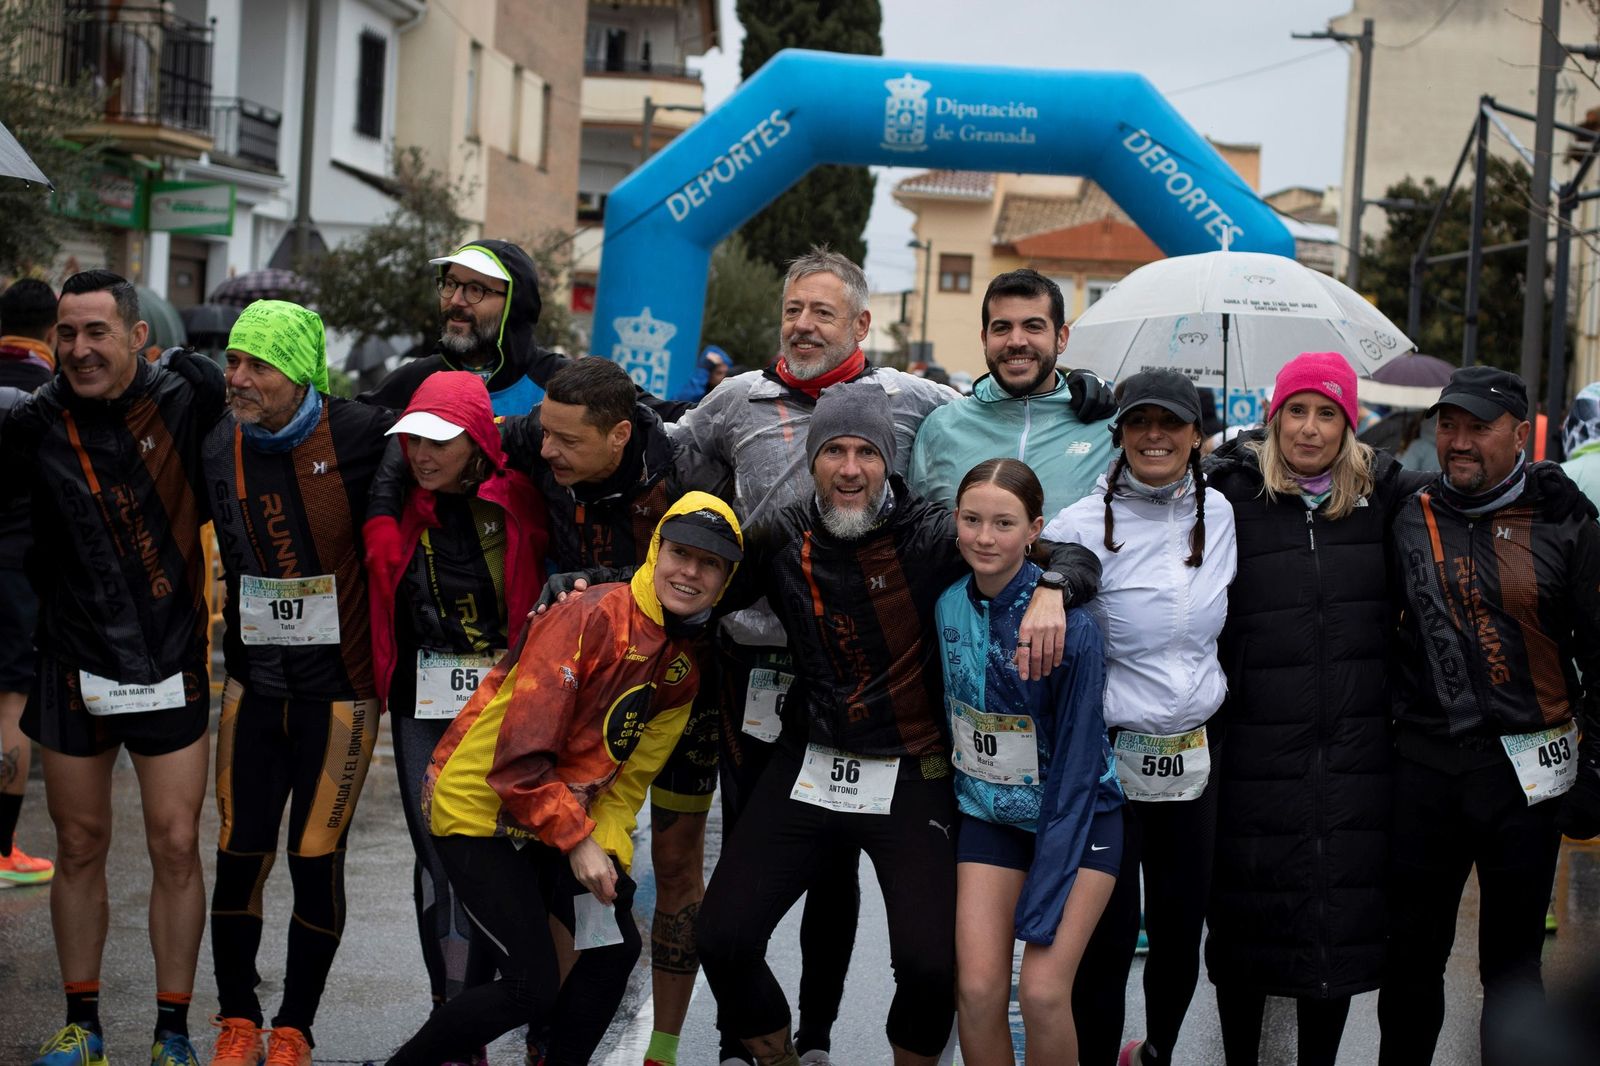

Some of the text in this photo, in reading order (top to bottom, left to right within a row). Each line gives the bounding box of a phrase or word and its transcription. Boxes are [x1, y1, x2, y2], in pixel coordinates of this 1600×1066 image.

[936, 97, 1038, 120] Diputación
[933, 123, 1036, 144] de Granada
[665, 109, 792, 222] DEPORTES
[1122, 128, 1245, 247] DEPORTES
[215, 480, 249, 572] GRAN
[258, 492, 302, 578] RUNN
[268, 598, 304, 620] 197
[1453, 555, 1512, 687] RUNNING
[1408, 547, 1466, 704] GRANADA
[421, 658, 459, 668] SECADEROS
[109, 688, 155, 697] FRAN MARTIN
[450, 668, 479, 691] 65
[347, 710, 366, 756] RUNNING
[973, 730, 998, 756] 60
[1120, 740, 1160, 755] SECADEROS
[1538, 736, 1571, 768] 493
[344, 760, 358, 772] EL
[830, 758, 860, 784] 56
[1142, 754, 1184, 778] 590
[828, 784, 858, 796] ANTONIO
[326, 784, 353, 828] GRANADA
